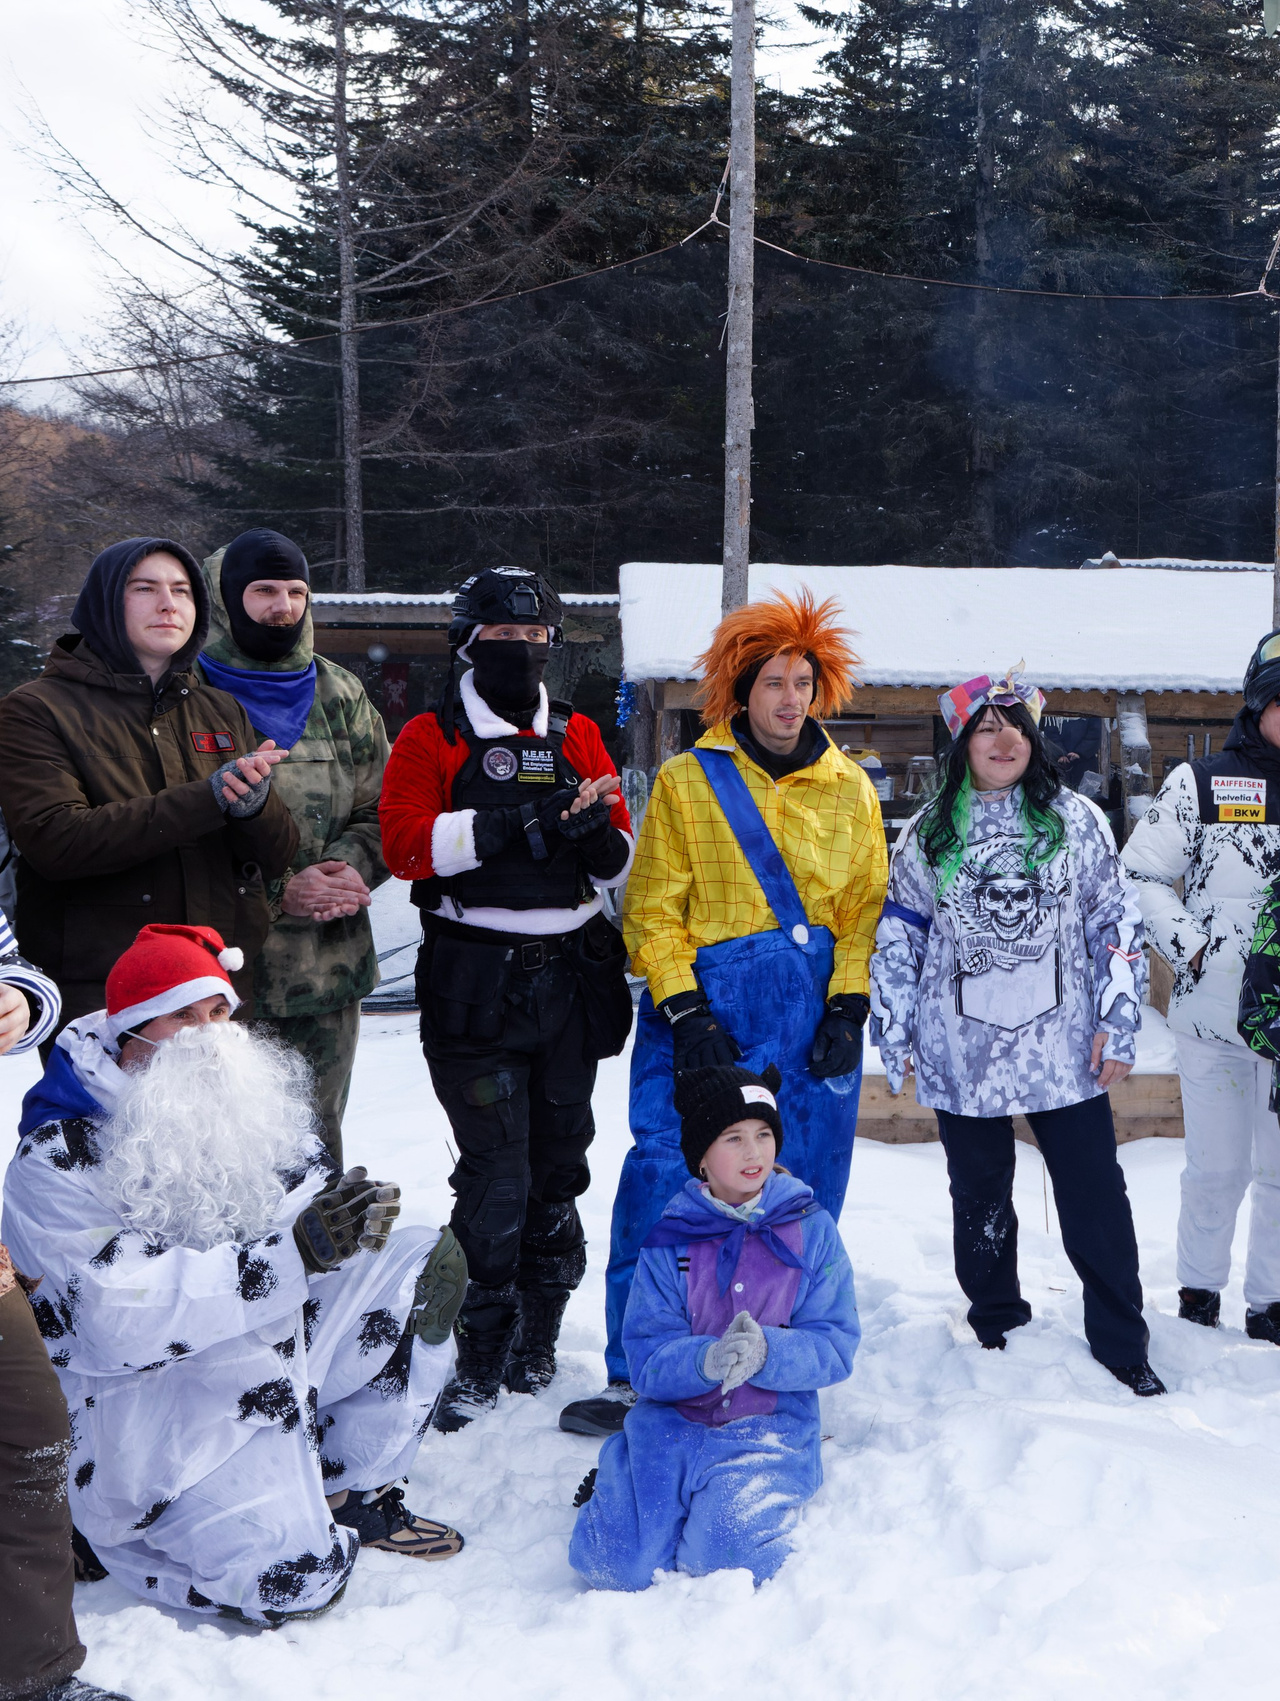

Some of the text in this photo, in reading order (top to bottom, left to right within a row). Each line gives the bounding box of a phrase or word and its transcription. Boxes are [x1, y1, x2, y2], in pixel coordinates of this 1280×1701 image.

[522, 750, 553, 759] N.E.E.T.
[1214, 780, 1263, 789] RAIFFEISEN
[1234, 808, 1260, 817] BKW
